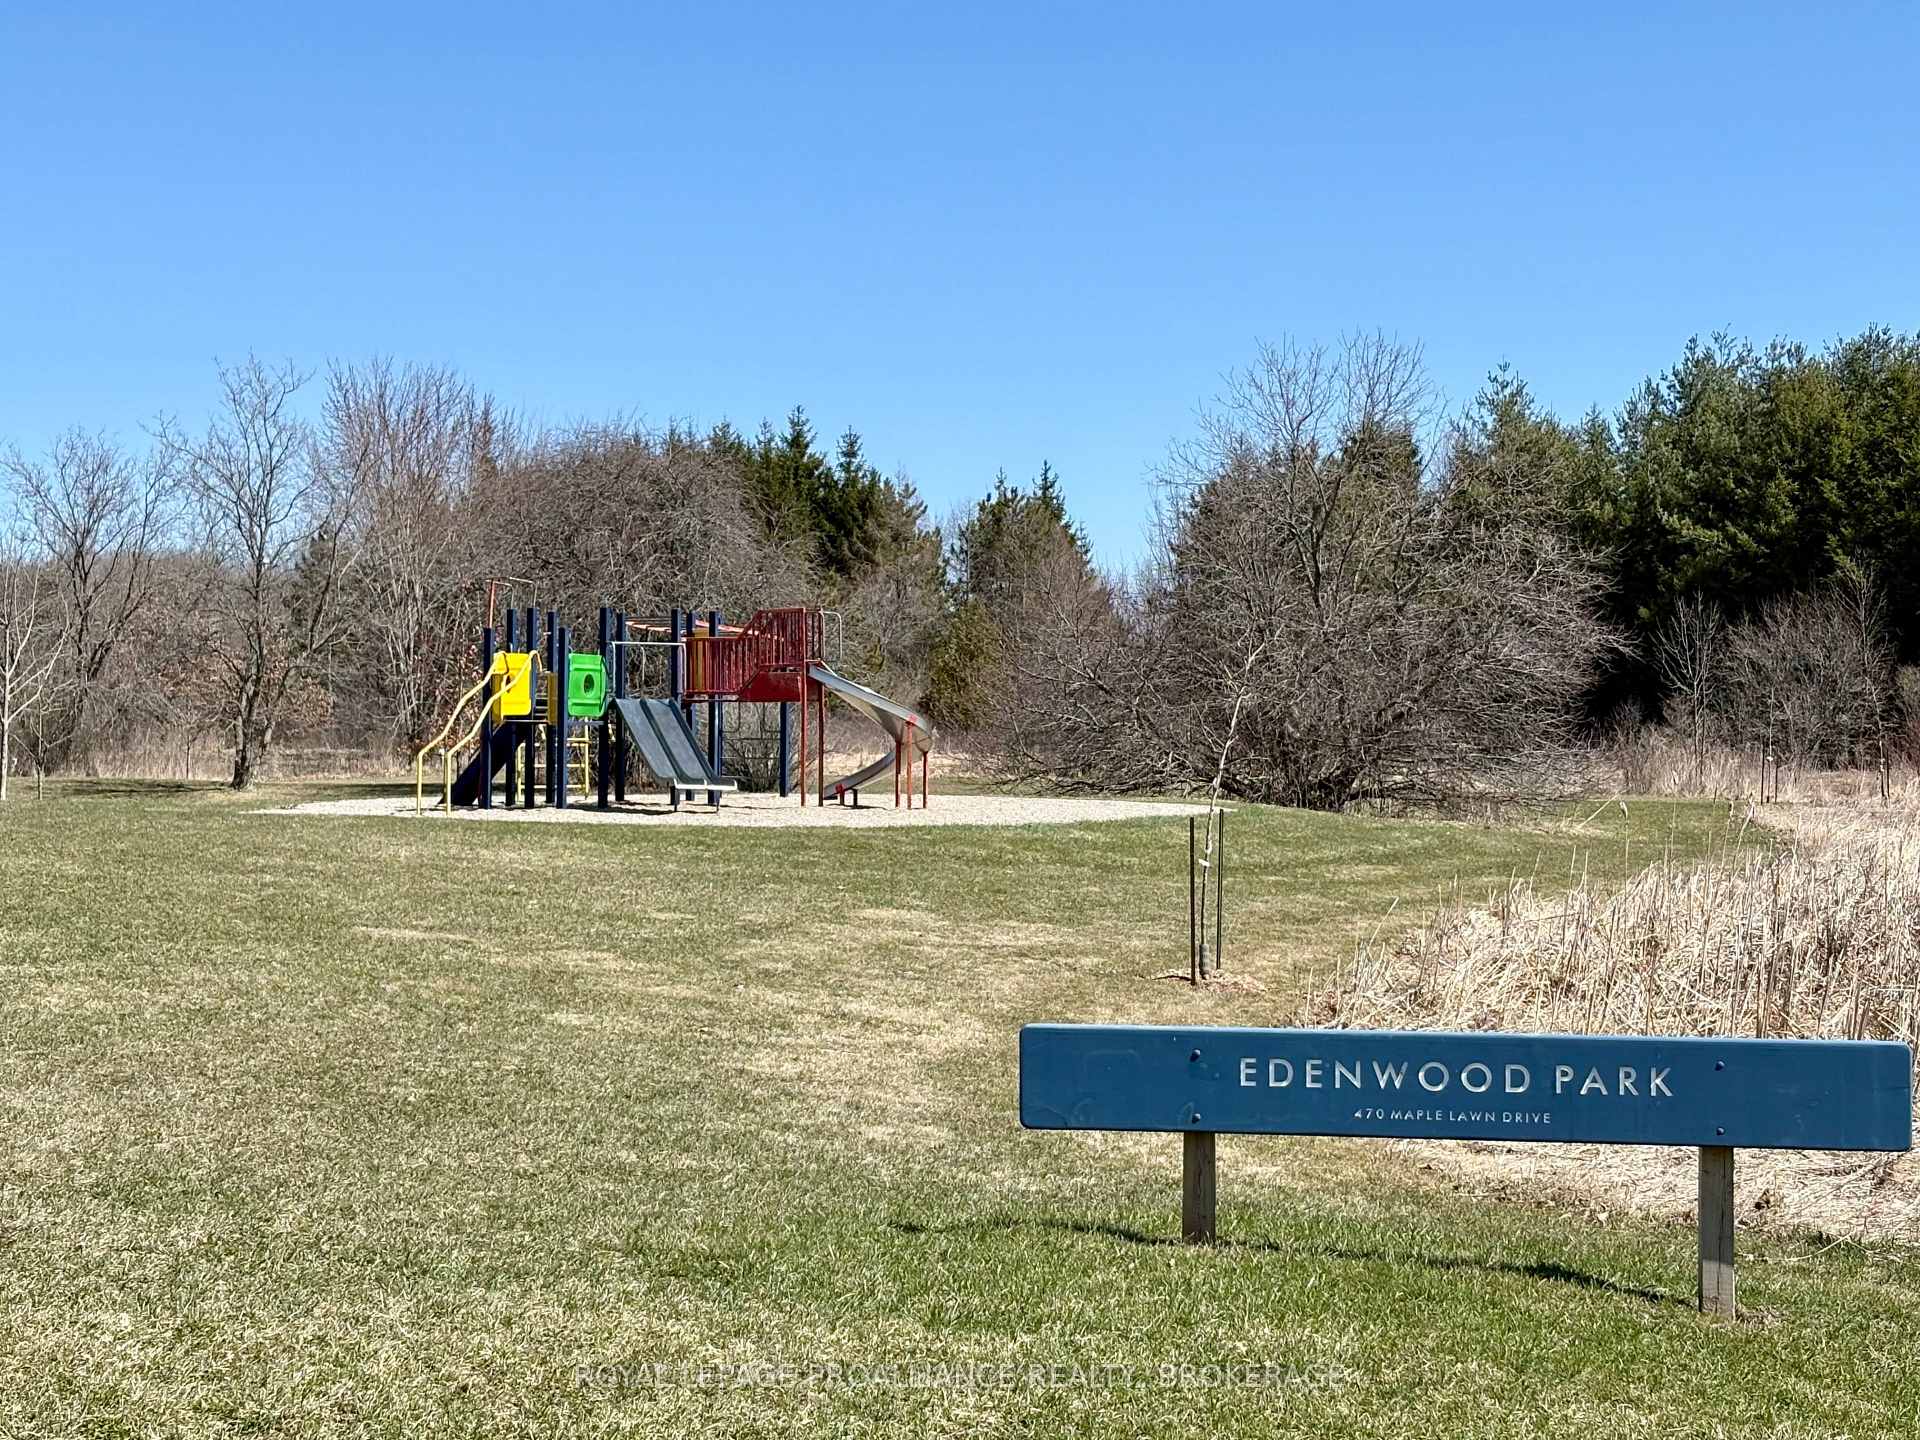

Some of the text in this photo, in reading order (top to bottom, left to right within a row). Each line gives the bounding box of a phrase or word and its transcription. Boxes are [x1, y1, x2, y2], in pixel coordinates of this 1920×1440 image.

[1239, 1057, 1674, 1098] EDENWOOD PARK
[1354, 1108, 1551, 1125] 470 MAPLE LAWN DRIVE
